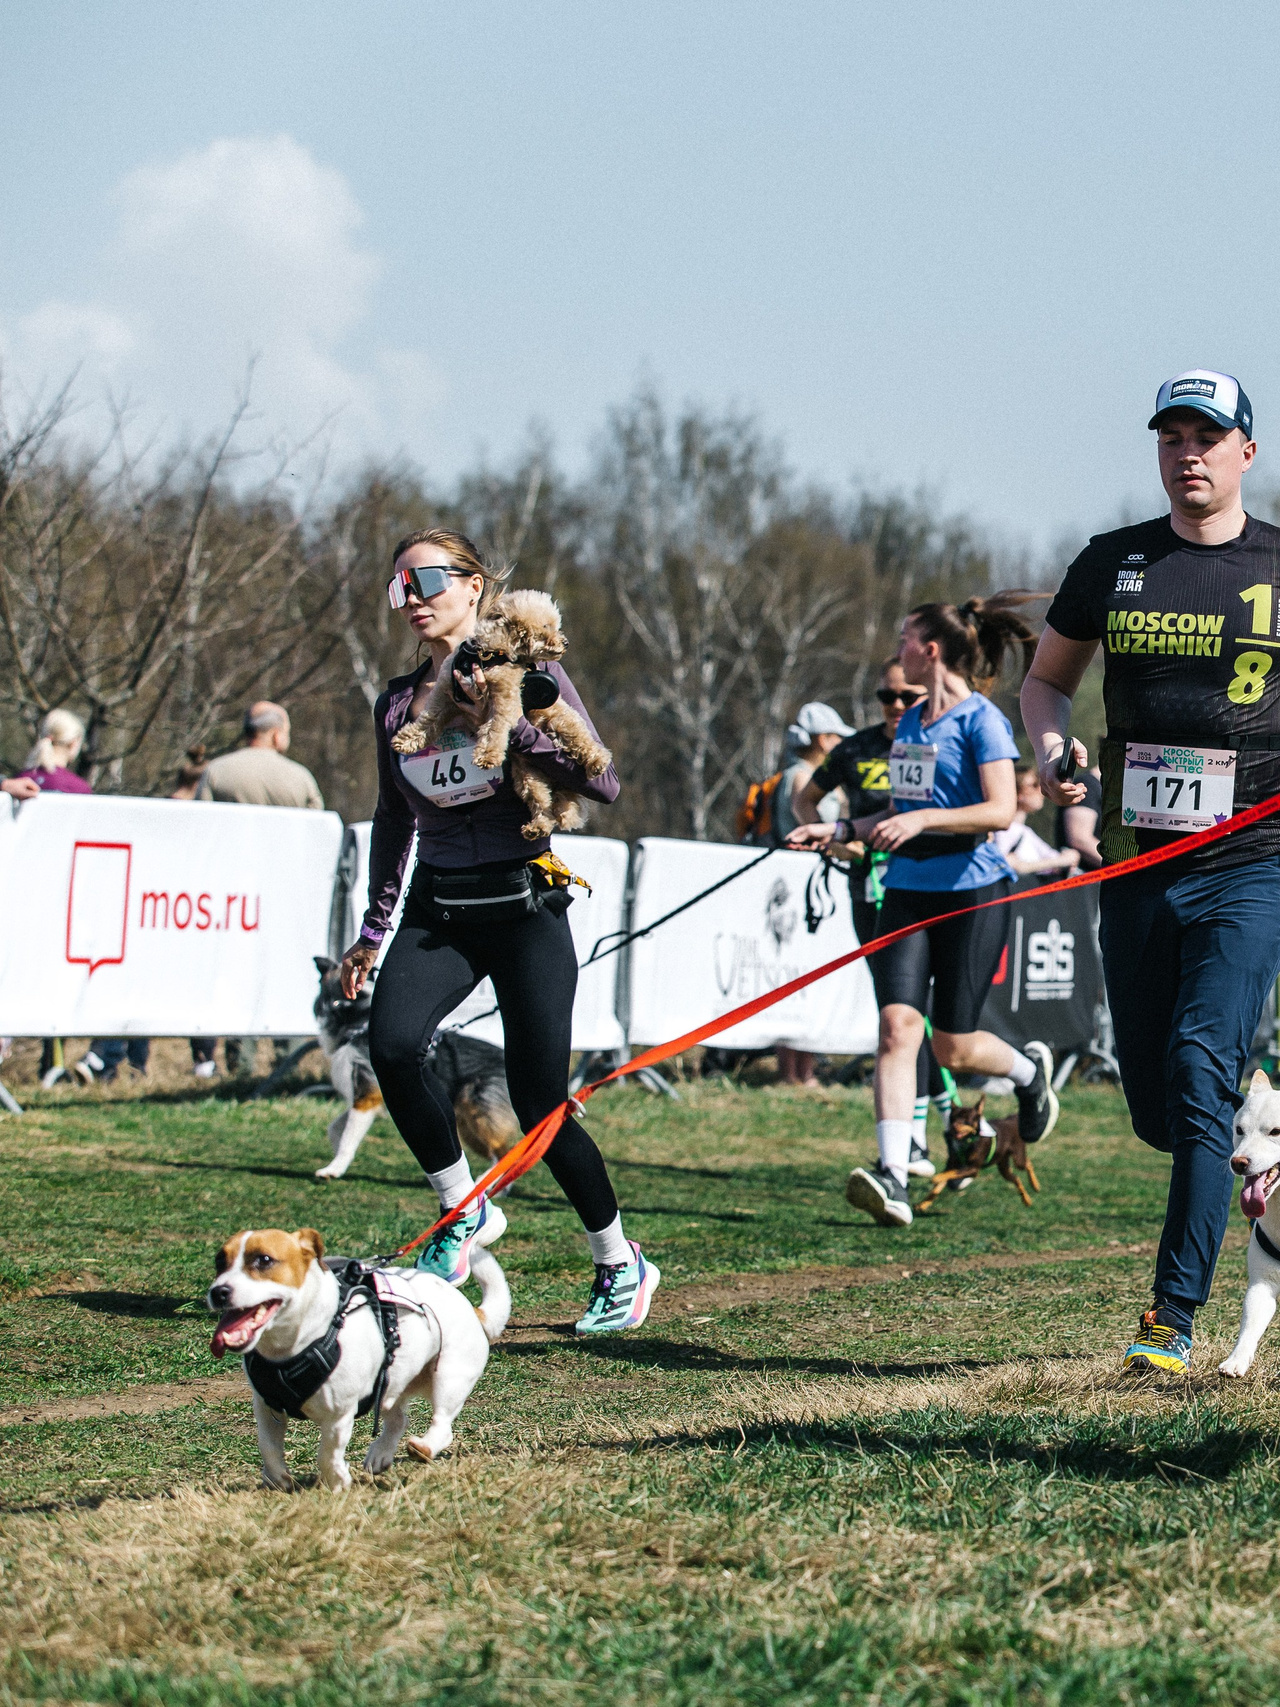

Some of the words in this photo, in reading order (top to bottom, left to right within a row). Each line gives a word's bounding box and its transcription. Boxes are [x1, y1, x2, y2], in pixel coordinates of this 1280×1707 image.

[1115, 580, 1144, 592] STAR
[1117, 570, 1138, 580] IRON
[1239, 583, 1272, 635] 1
[1106, 610, 1225, 635] MOSCOW
[1107, 633, 1223, 658] LUZHNIKI
[1227, 650, 1273, 705] 8
[1163, 747, 1196, 757] КРОСС
[1163, 755, 1204, 767] БЫСТРЫЙ
[431, 755, 466, 788] 46
[899, 764, 923, 786] 143
[1146, 776, 1202, 811] 171
[140, 891, 260, 932] mos.ru
